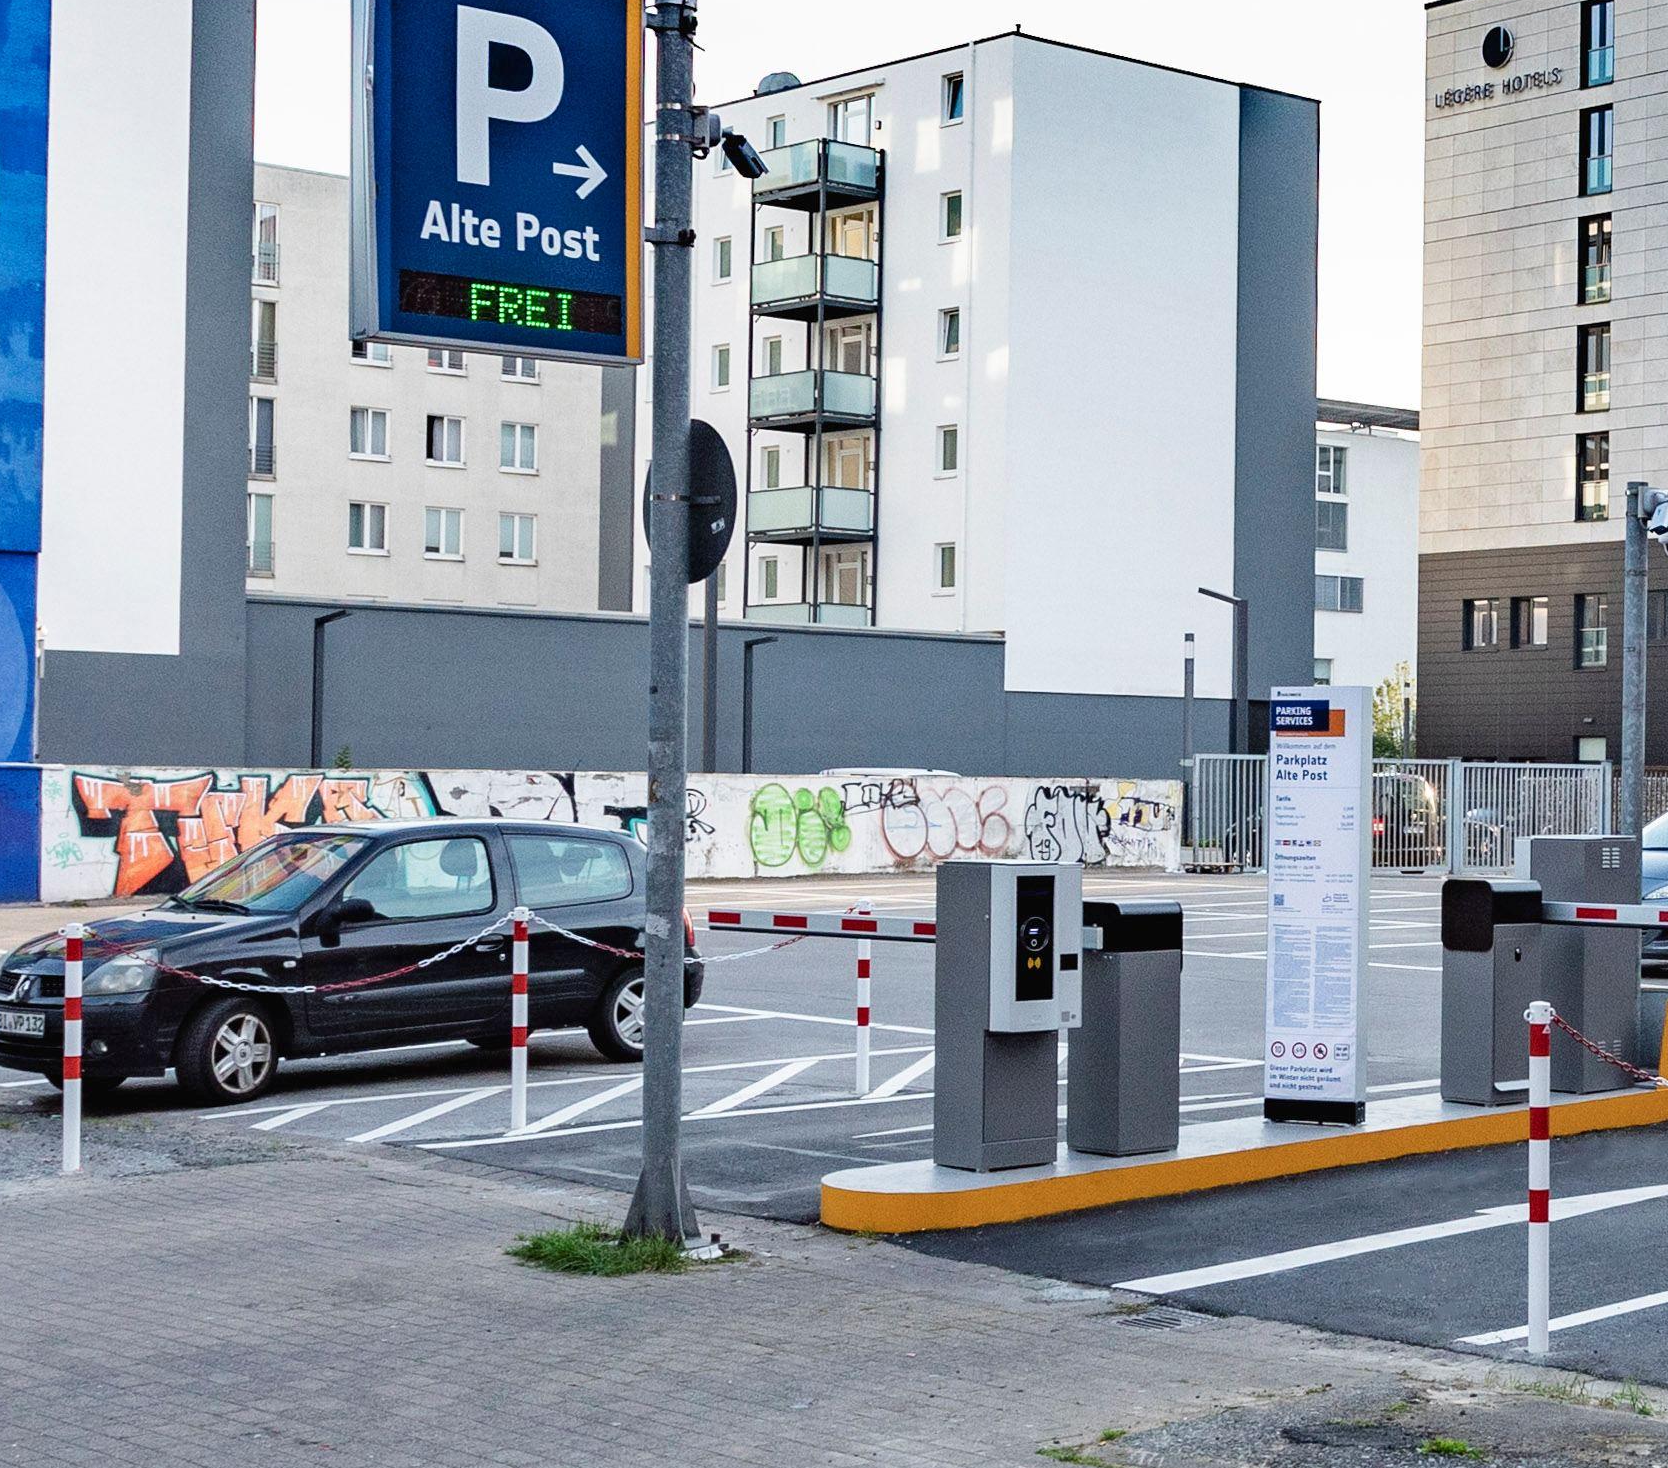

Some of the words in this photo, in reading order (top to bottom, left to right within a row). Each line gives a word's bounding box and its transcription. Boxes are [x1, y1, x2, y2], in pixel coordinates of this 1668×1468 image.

[1502, 67, 1563, 94] HOTELS
[456, 4, 565, 186] P
[420, 200, 501, 248] Alte
[516, 212, 600, 262] Post
[470, 282, 574, 331] FREI
[1276, 706, 1312, 715] PARKING
[1276, 716, 1314, 726] SERVICES
[1276, 754, 1327, 767] Parkplatz
[1276, 770, 1298, 780] Alte
[1302, 770, 1328, 781] Post
